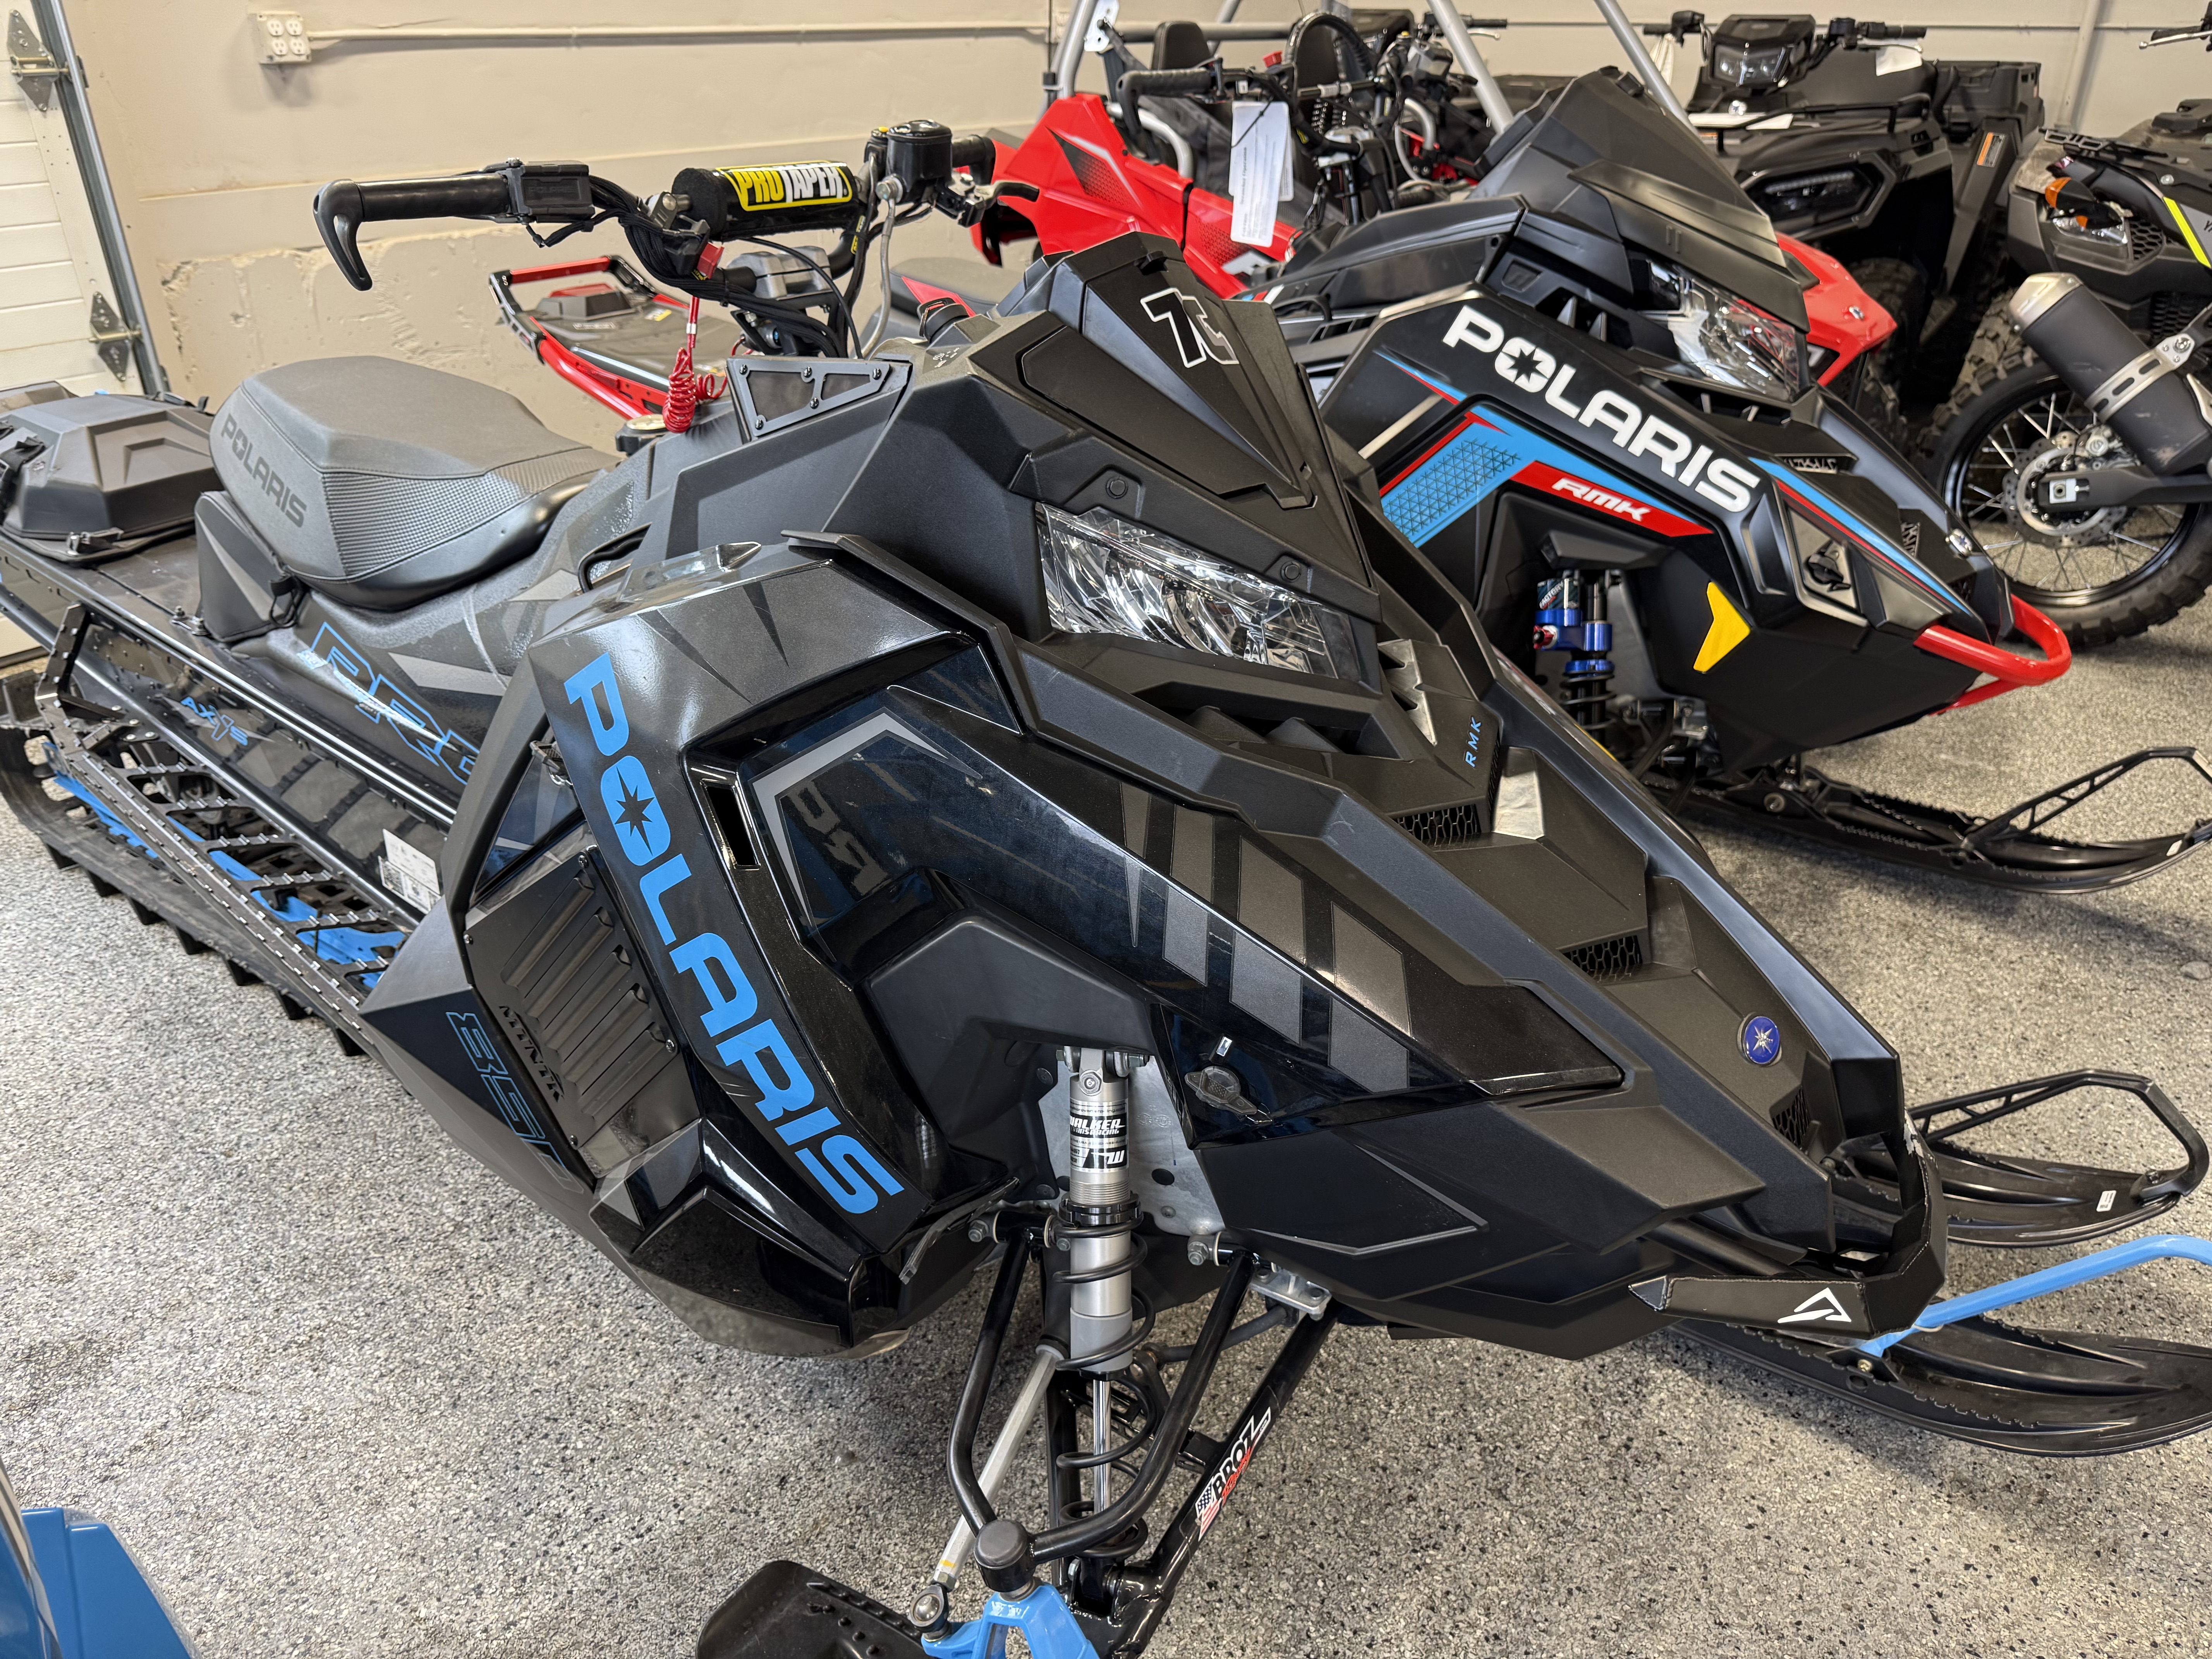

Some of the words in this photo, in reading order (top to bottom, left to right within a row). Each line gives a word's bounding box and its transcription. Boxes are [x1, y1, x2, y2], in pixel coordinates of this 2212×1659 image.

[1443, 305, 1759, 512] POLARIS
[221, 414, 307, 527] POLARIS
[1551, 477, 1651, 522] RMK
[180, 697, 248, 746] AXYS
[1465, 716, 1482, 767] RMK
[564, 652, 904, 1214] POLARIS
[446, 1012, 584, 1194] 850
